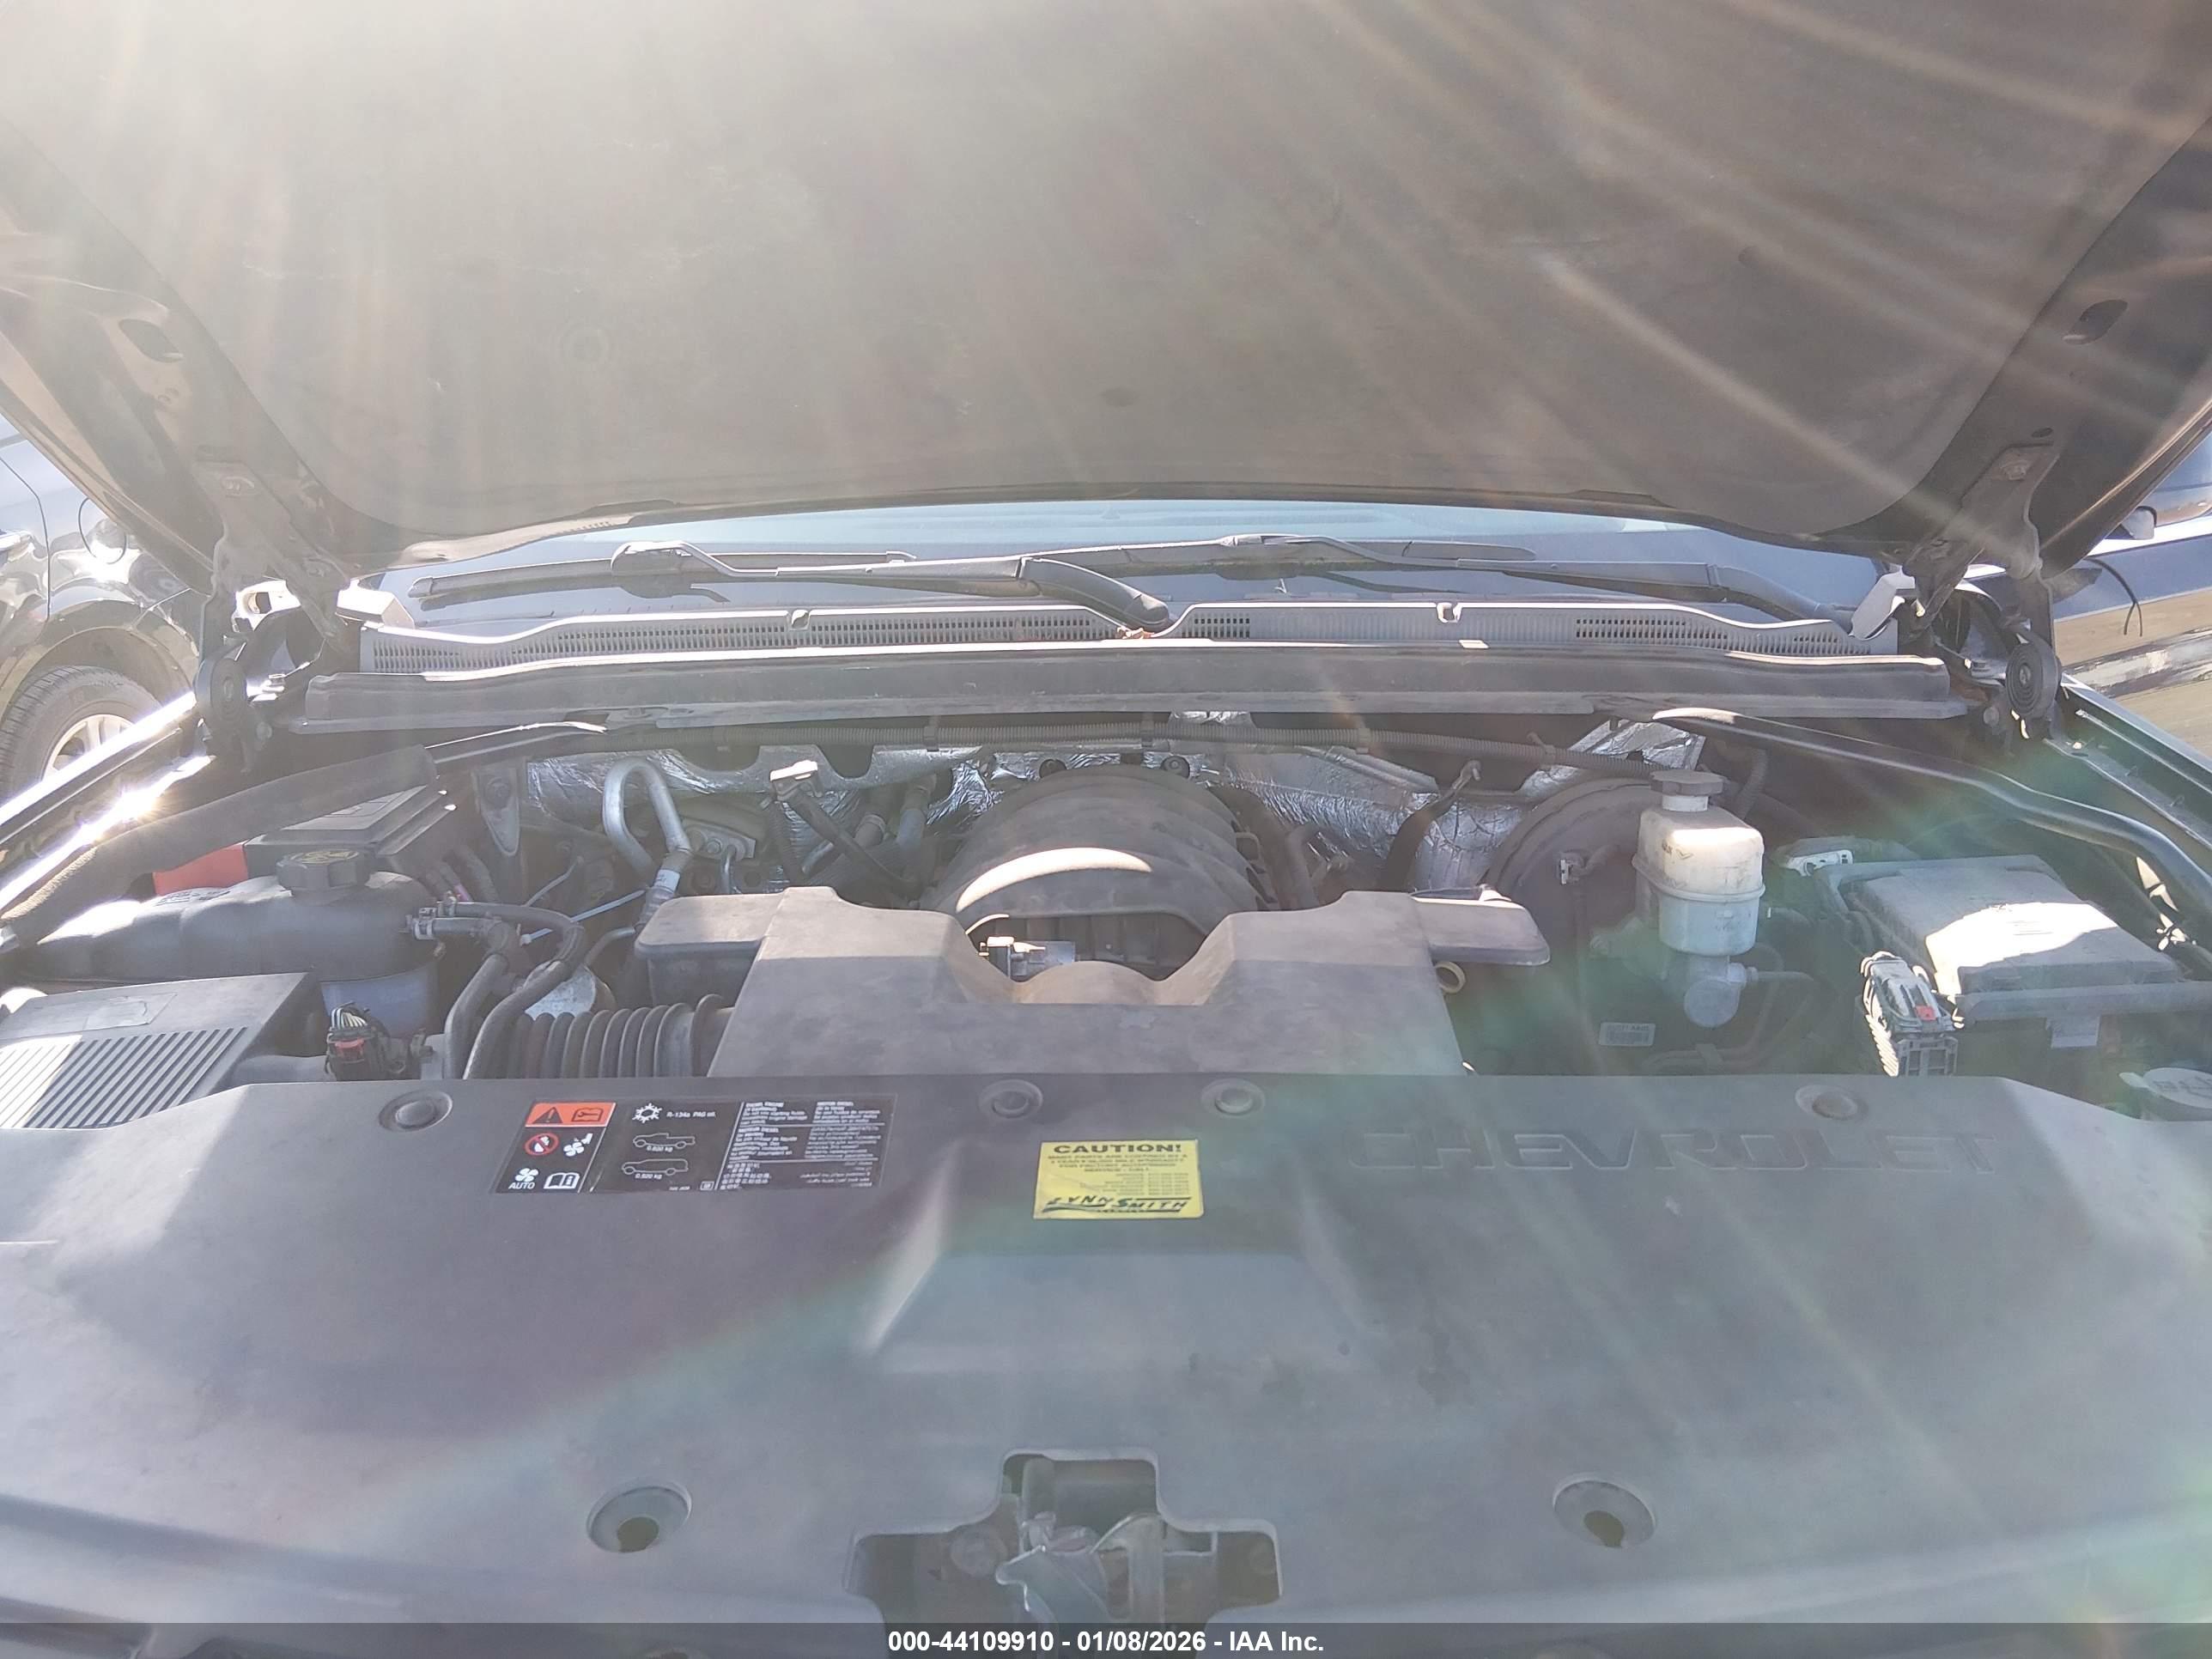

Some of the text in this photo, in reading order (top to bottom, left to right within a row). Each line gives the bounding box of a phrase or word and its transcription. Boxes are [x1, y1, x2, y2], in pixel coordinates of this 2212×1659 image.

[1054, 1144, 1182, 1153] CAUTION!
[1348, 1127, 1996, 1174] CHEVROLET
[1114, 1199, 1188, 1209] SMITH
